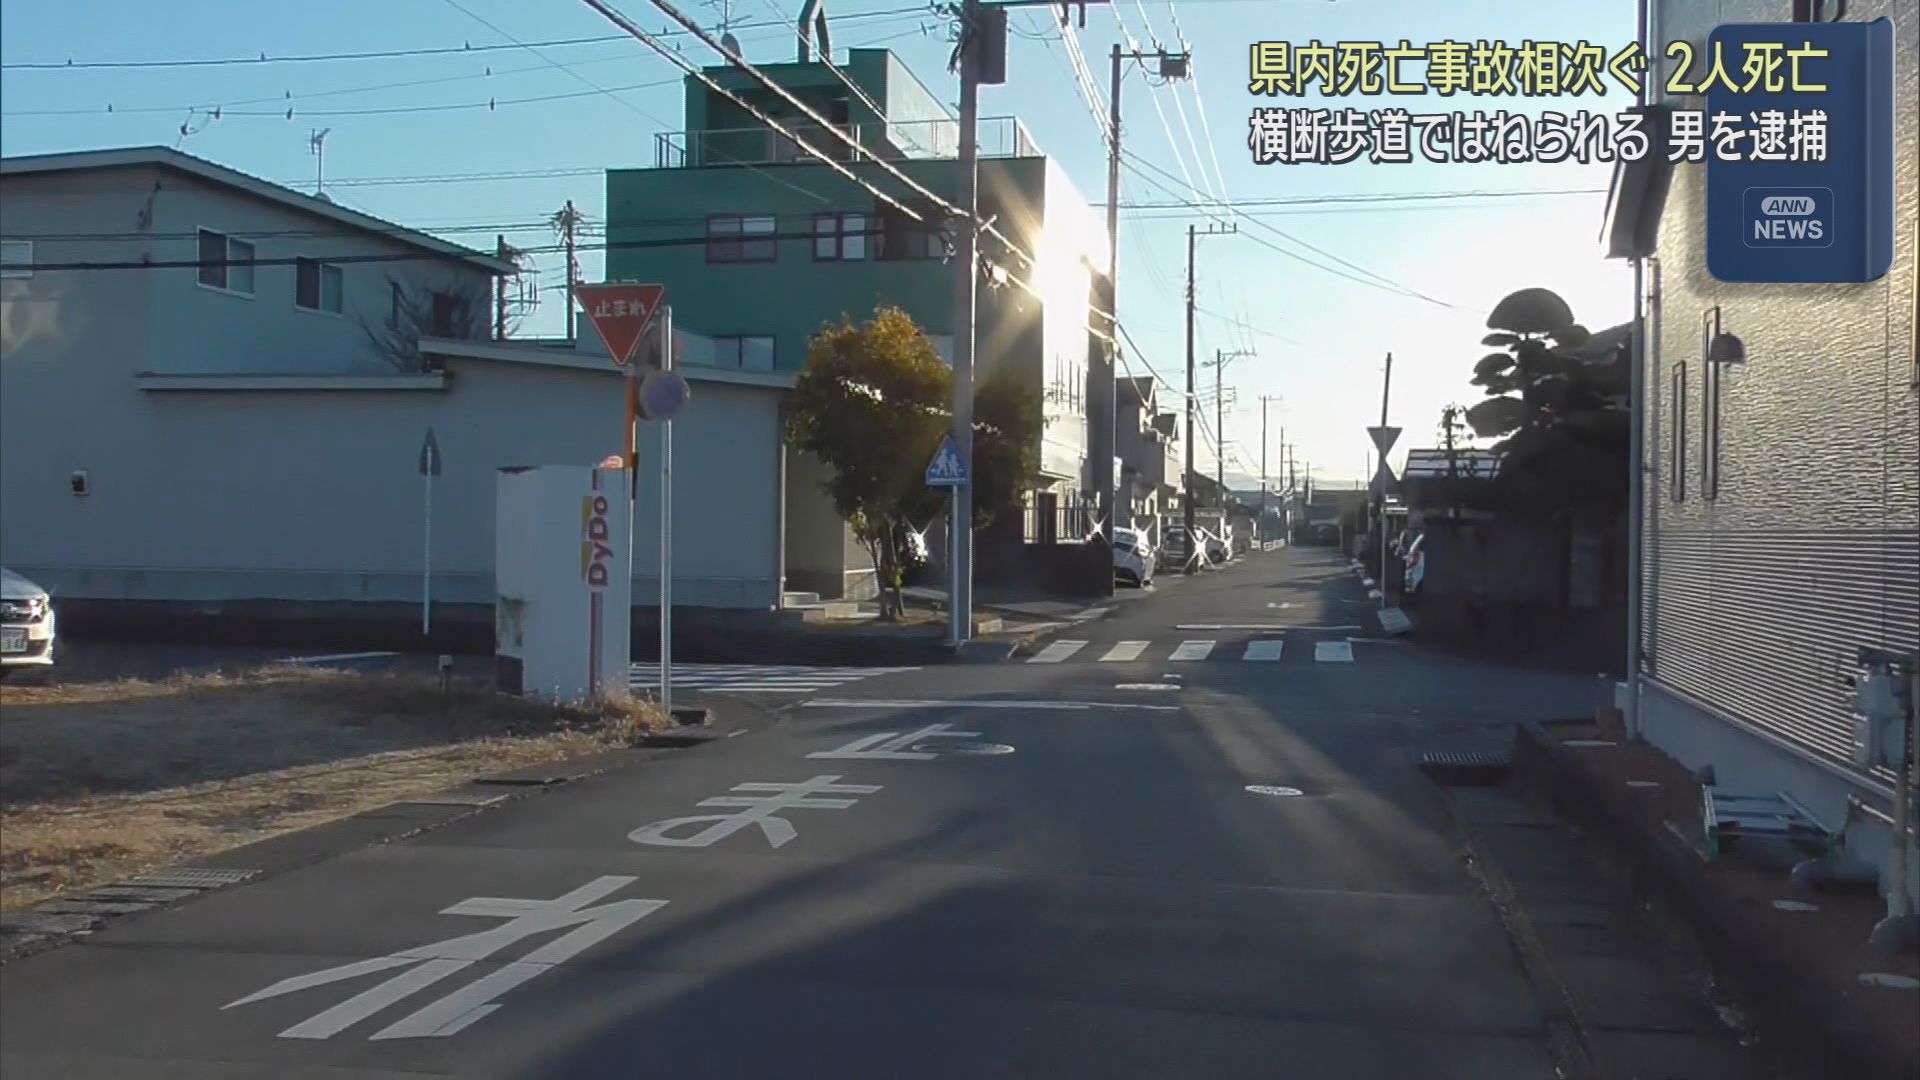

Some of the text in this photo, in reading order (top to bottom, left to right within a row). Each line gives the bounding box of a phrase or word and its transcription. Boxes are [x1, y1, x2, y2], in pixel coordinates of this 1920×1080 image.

[594, 298, 647, 318] 止まれ
[588, 495, 614, 588] DyDo
